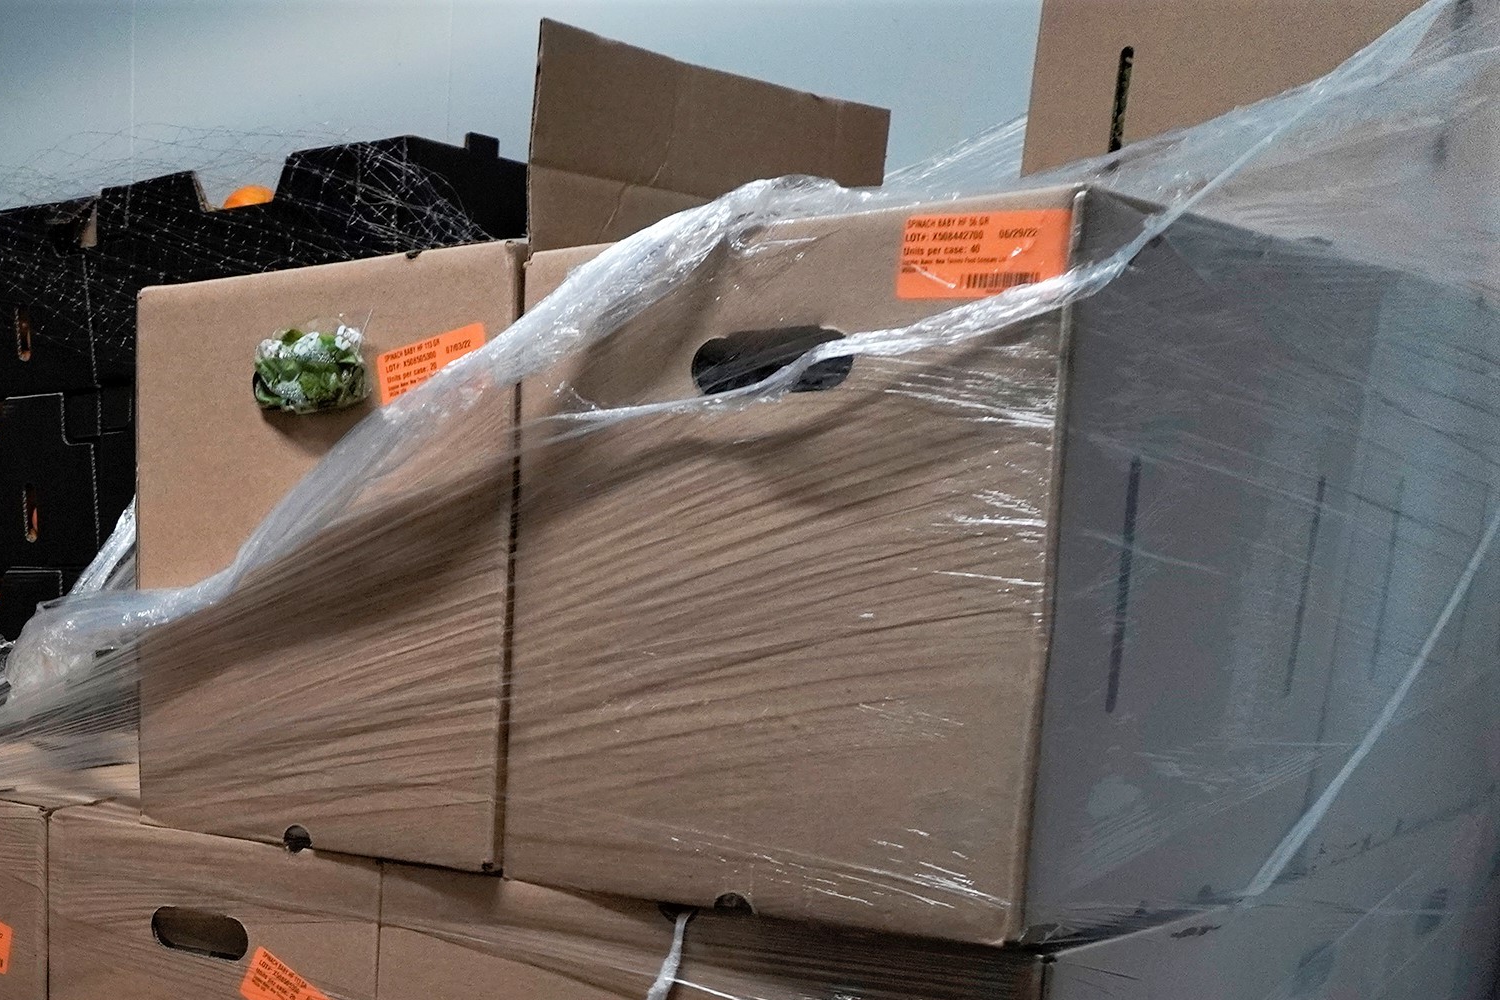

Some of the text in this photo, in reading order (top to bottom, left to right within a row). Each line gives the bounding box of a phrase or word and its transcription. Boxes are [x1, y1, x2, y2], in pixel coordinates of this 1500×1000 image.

[907, 217, 936, 228] SPINACH
[938, 217, 956, 227] BABY
[904, 246, 925, 256] Units
[927, 247, 942, 257] per
[943, 246, 968, 255] case:
[384, 351, 403, 362] SPINACH
[404, 347, 416, 356] BABY
[387, 375, 401, 383] Units
[403, 371, 412, 380] per
